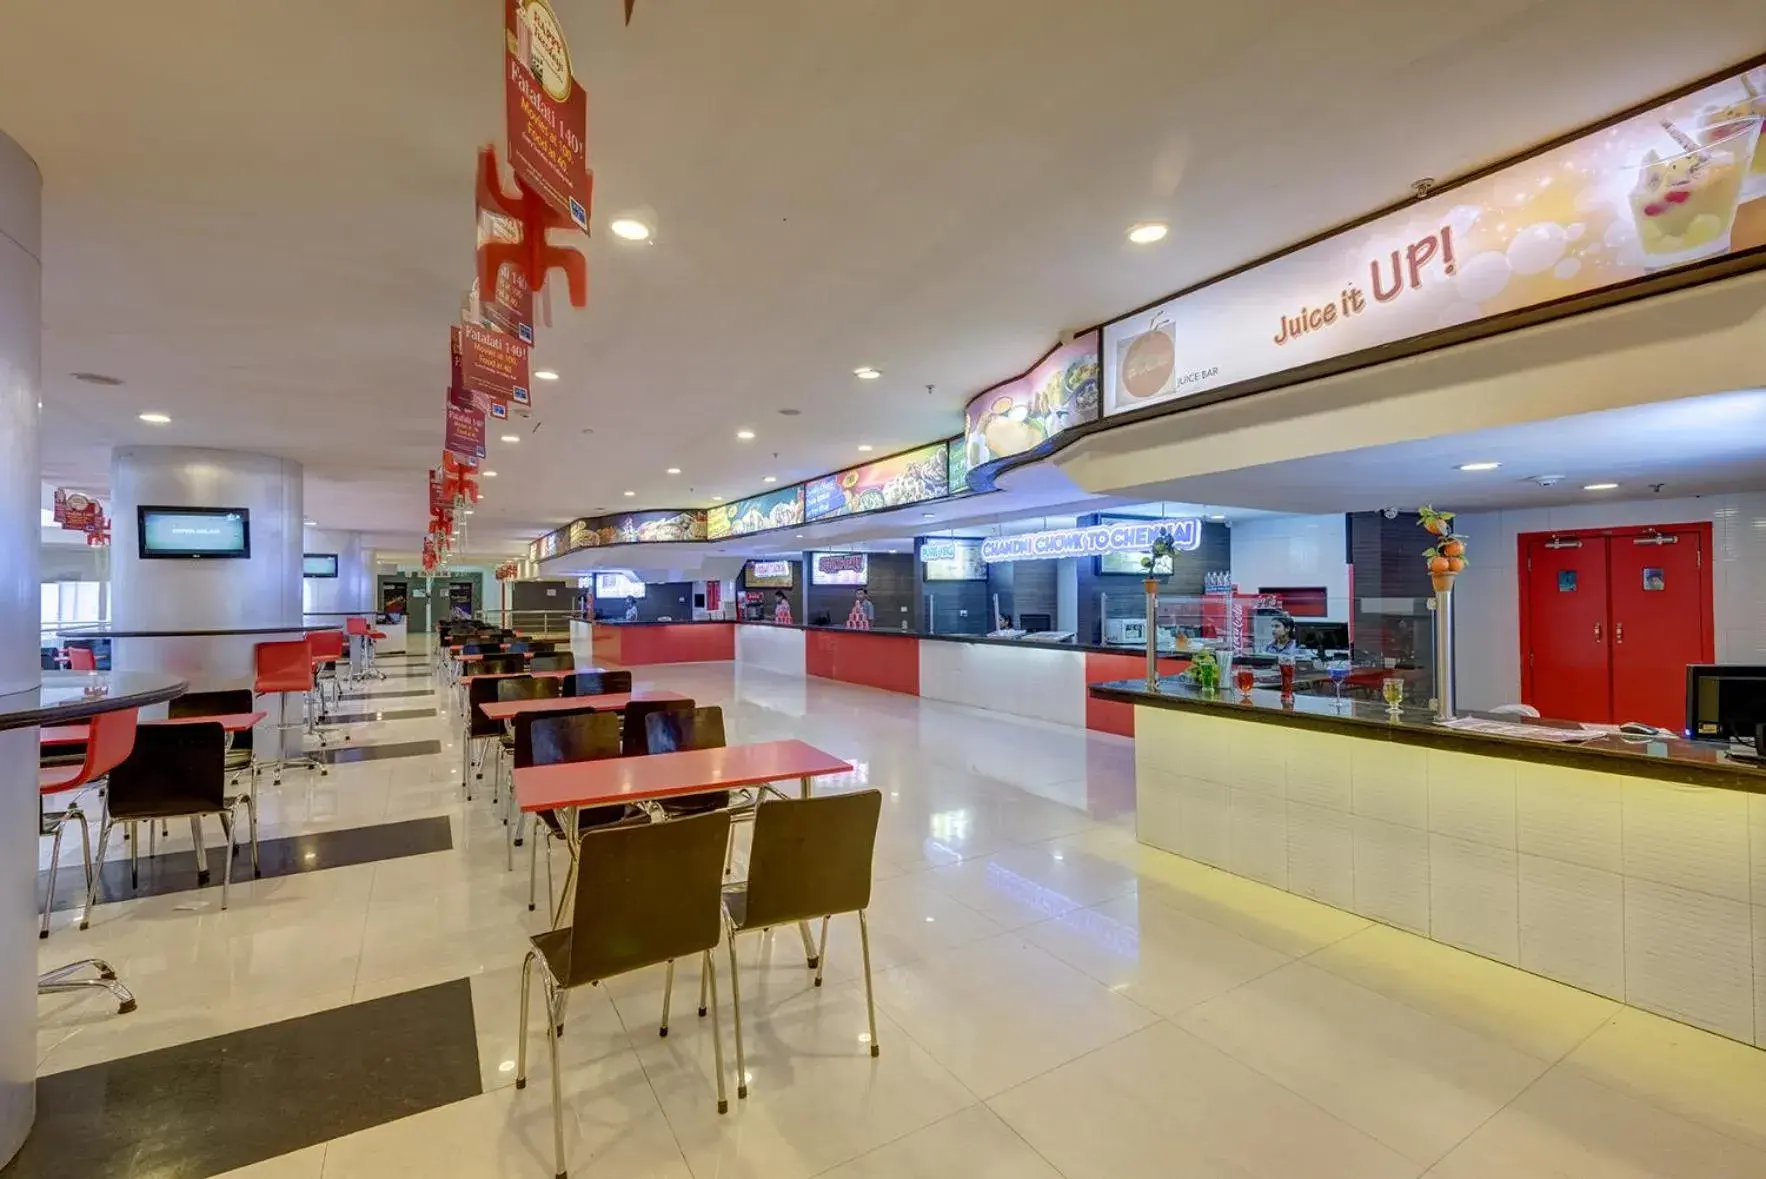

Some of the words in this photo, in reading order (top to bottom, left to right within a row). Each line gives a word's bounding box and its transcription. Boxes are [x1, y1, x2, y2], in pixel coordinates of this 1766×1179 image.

[1274, 307, 1337, 345] Juice
[1341, 288, 1366, 317] it
[1370, 226, 1457, 303] UP!
[1202, 367, 1218, 380] BAR
[1034, 532, 1082, 554] CHOWK
[1087, 529, 1110, 551] TO
